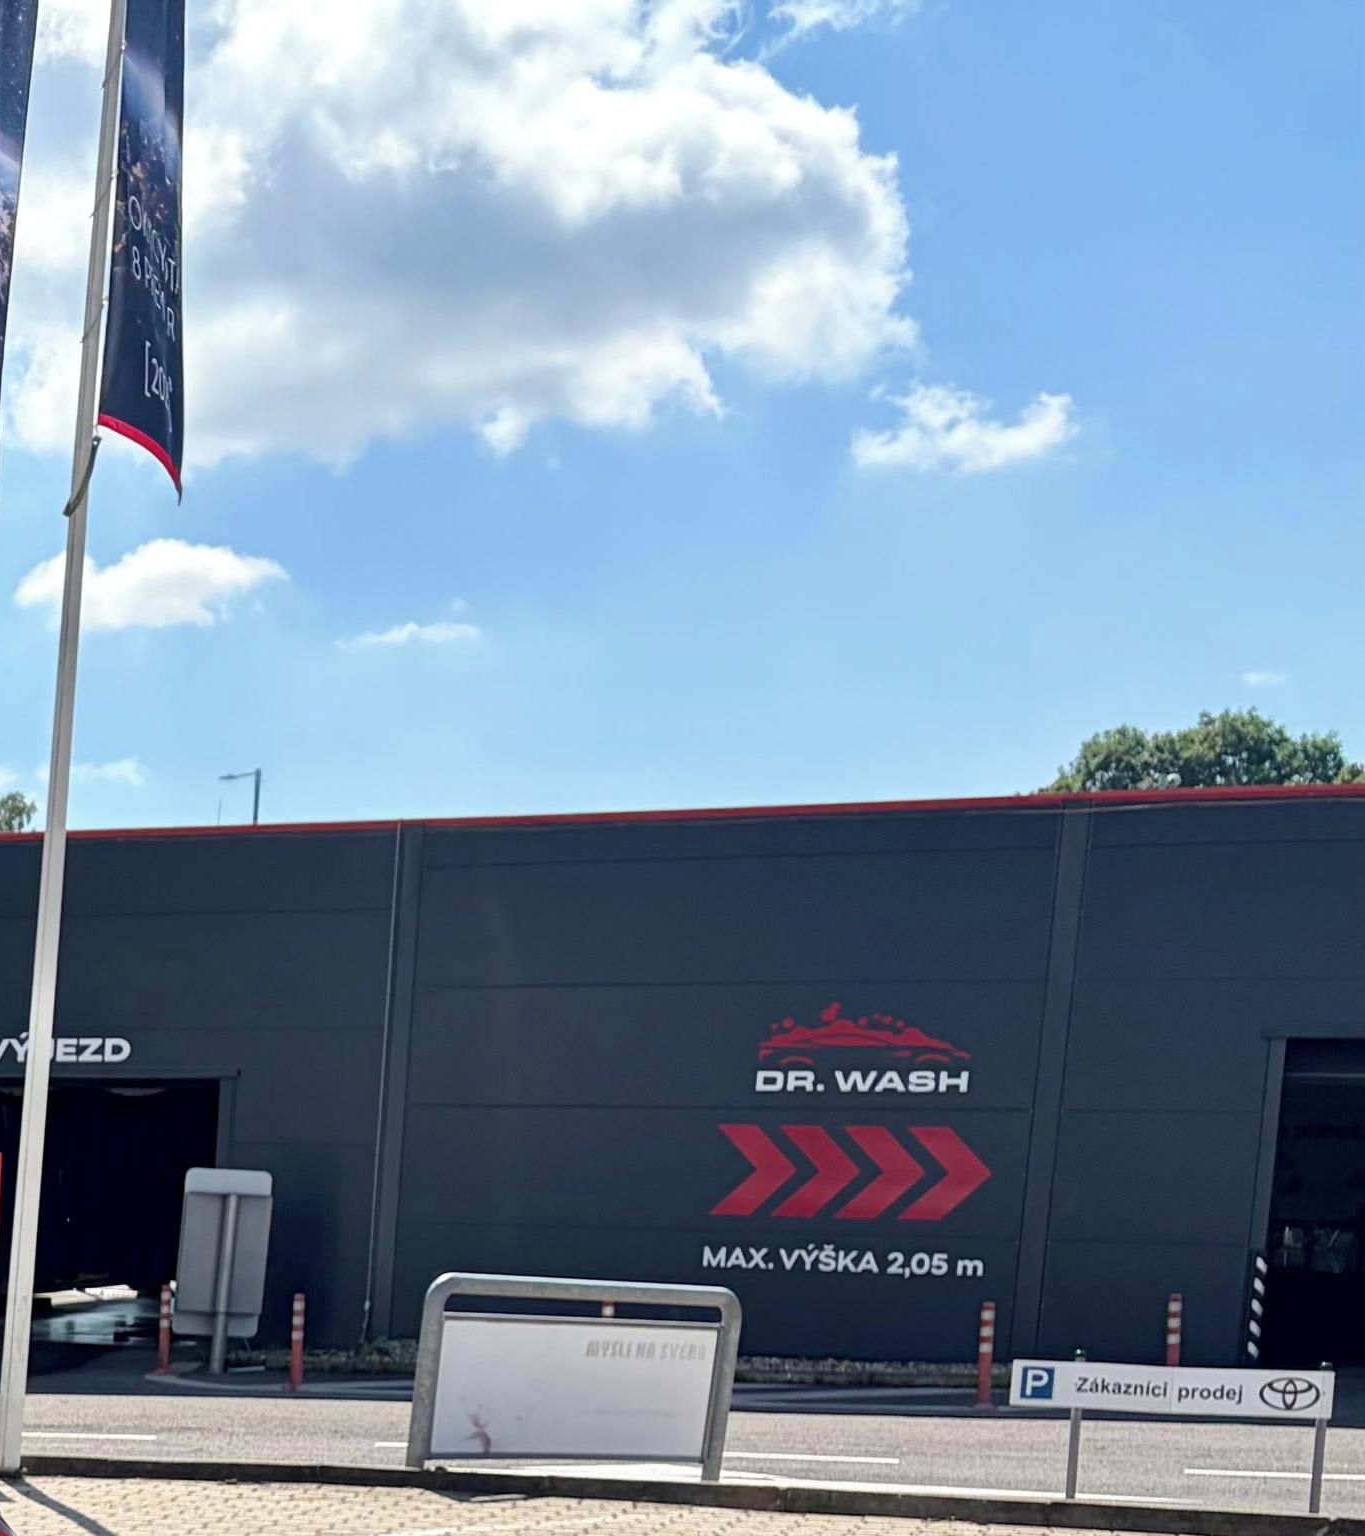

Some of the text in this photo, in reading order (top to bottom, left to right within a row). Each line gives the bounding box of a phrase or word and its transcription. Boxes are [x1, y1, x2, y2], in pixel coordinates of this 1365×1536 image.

[755, 1070, 970, 1093] DR. WASH
[702, 1244, 984, 1279] MAX. VÝŠKA 2,05 m
[1075, 1376, 1168, 1398] Zákazníci
[1177, 1384, 1244, 1405] prodej
